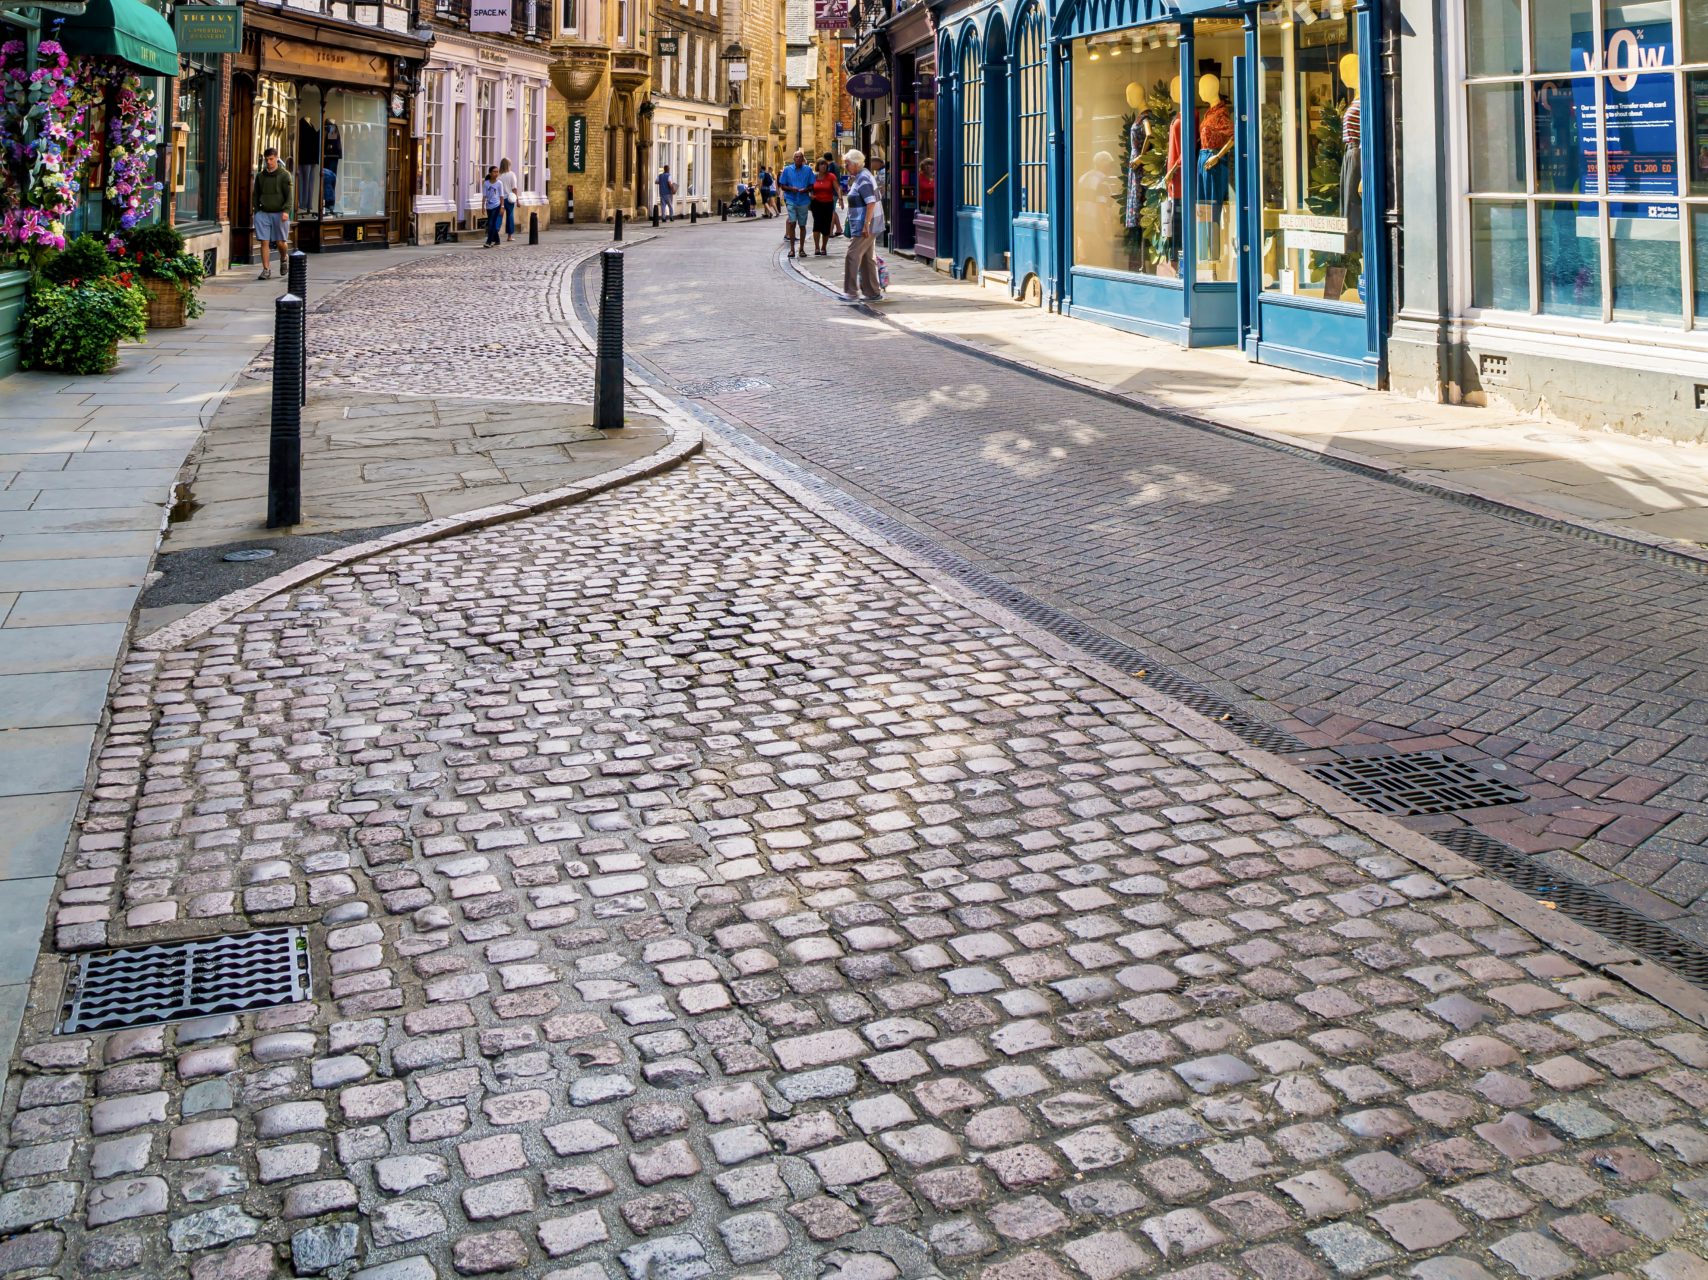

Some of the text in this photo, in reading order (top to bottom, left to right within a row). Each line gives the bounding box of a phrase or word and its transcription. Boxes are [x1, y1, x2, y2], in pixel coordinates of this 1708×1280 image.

[183, 14, 233, 22] THE IVY
[1634, 164, 1658, 174] £1,200
[1662, 164, 1671, 173] £0
